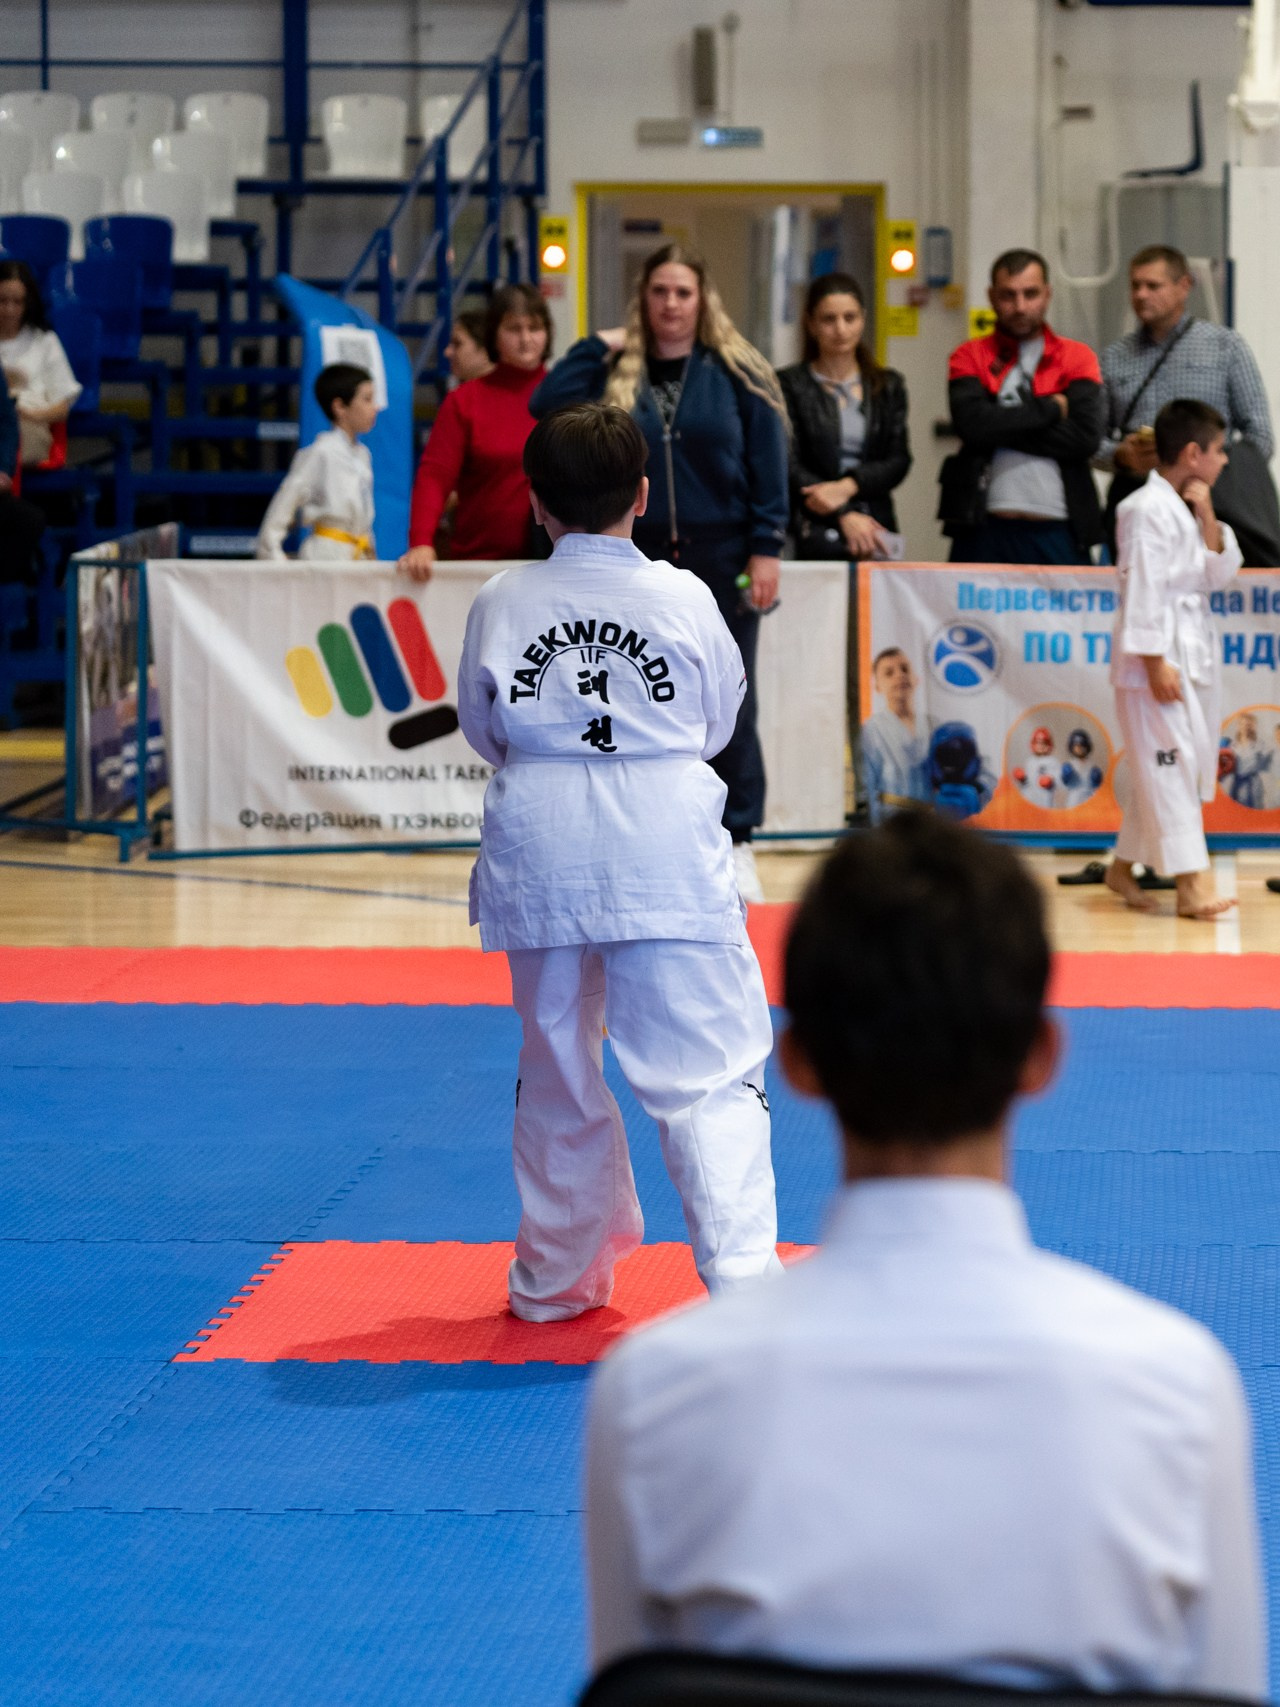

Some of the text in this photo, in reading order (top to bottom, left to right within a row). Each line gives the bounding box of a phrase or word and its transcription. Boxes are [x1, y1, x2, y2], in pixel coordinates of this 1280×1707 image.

[957, 582, 1119, 613] Первенств
[510, 619, 675, 704] TAEKWON-DO
[288, 763, 497, 782] INTERNATIONAL TAEK
[238, 808, 382, 832] Федерация
